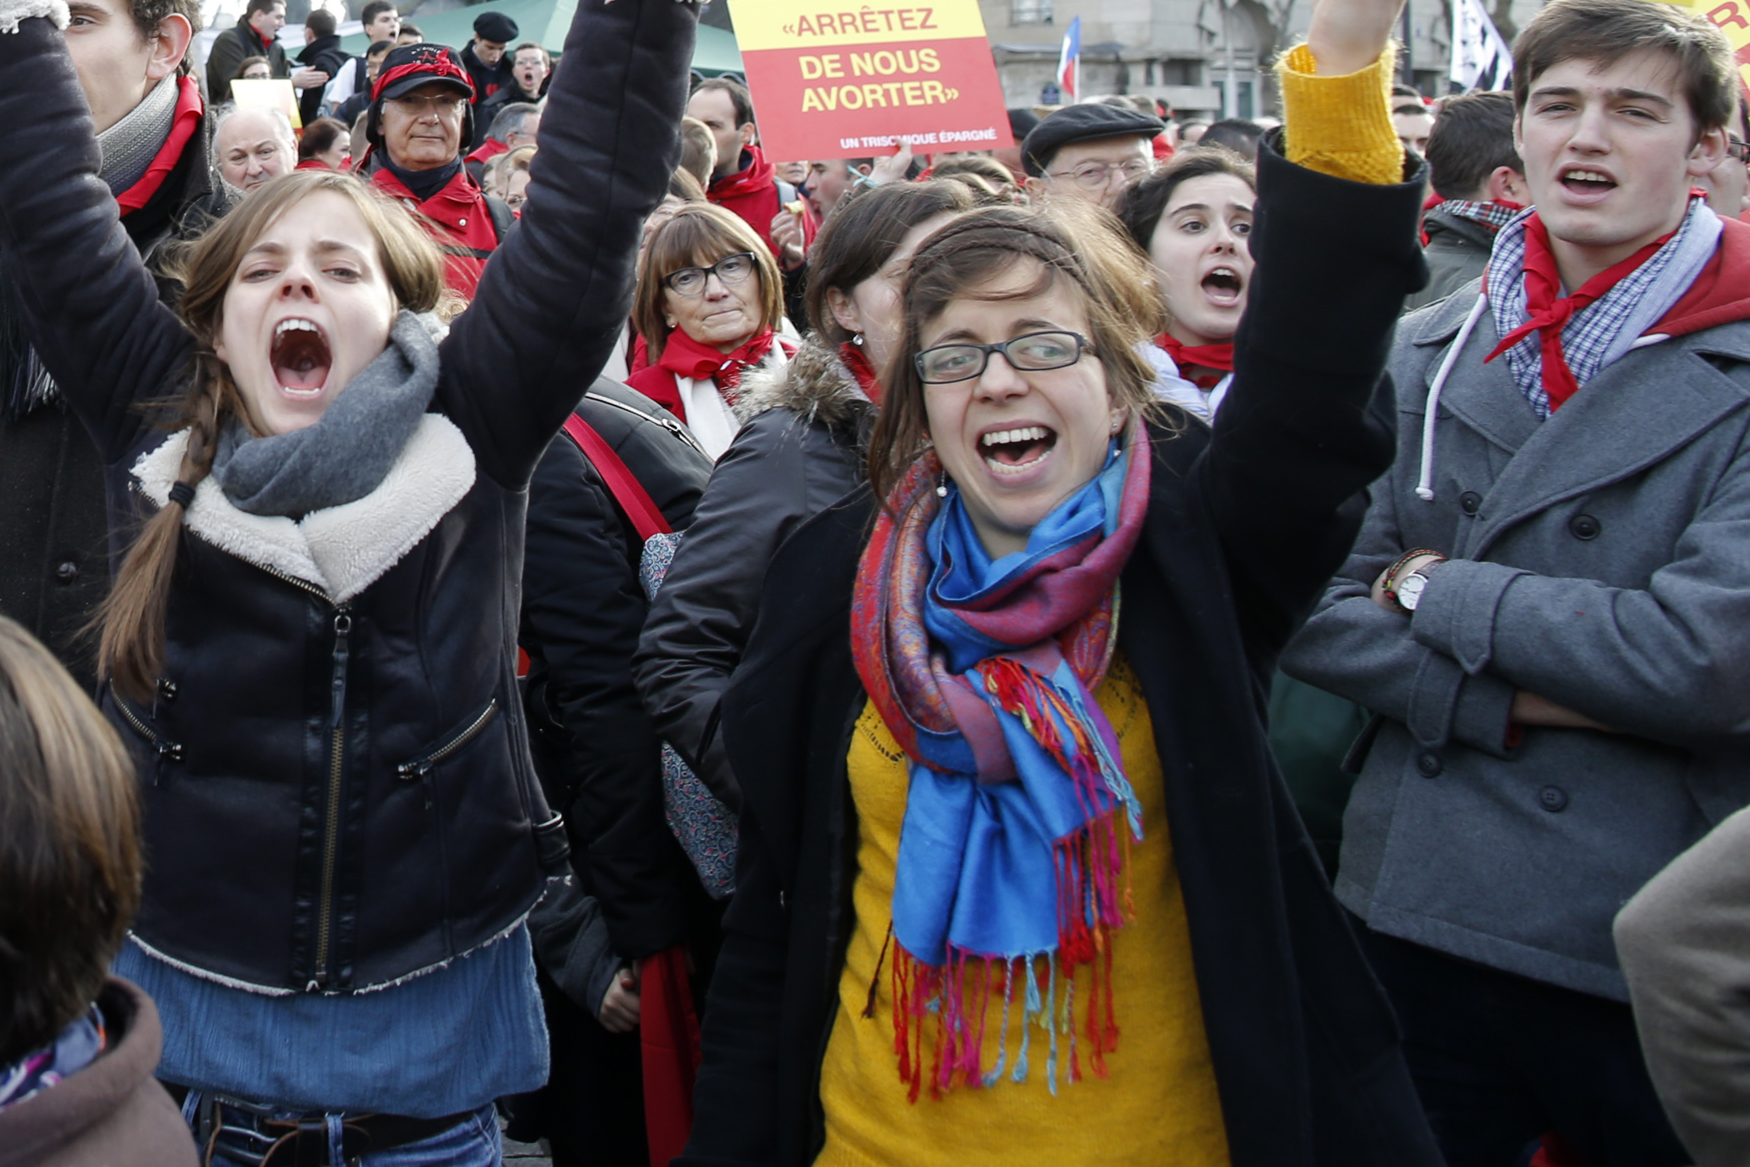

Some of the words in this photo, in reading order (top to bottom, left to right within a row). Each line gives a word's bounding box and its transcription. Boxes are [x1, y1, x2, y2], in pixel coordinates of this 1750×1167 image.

[782, 4, 938, 37] «ARRÊTEZ
[798, 54, 844, 80] DE
[850, 48, 941, 77] NOUS
[801, 80, 959, 113] AVORTER»
[840, 138, 859, 149] UN
[939, 127, 997, 144] ÉPARGNÉ
